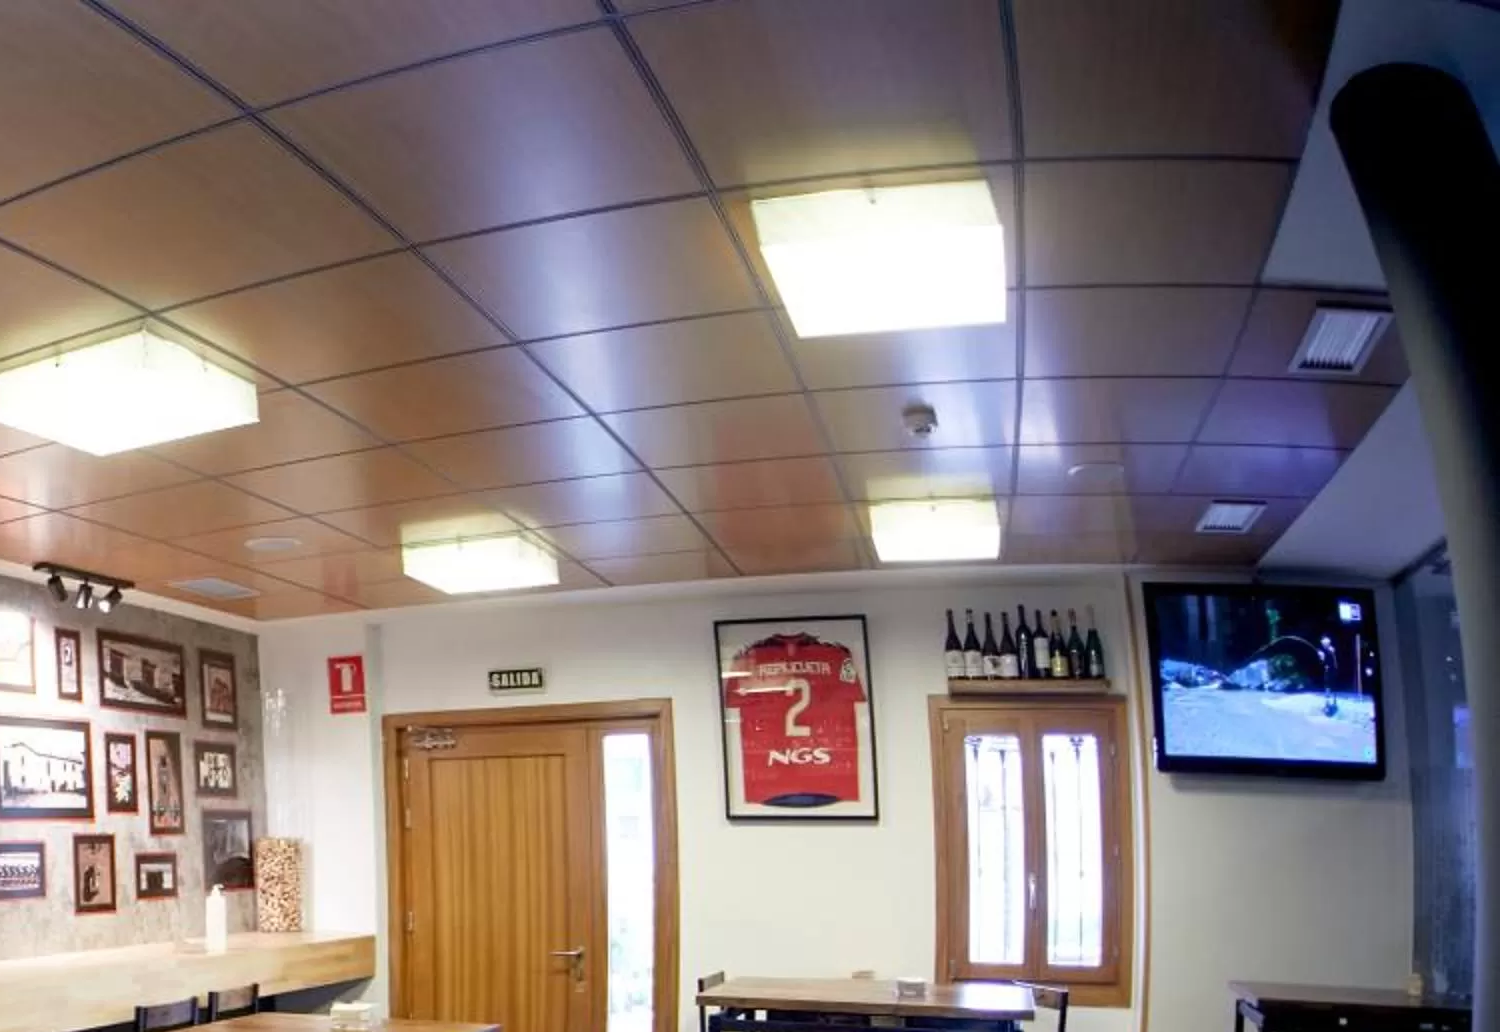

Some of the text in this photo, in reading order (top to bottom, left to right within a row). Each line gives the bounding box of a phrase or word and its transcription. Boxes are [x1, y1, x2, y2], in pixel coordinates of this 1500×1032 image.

[491, 671, 540, 687] SALIDA
[785, 678, 811, 737] 2
[767, 747, 832, 768] NGS
